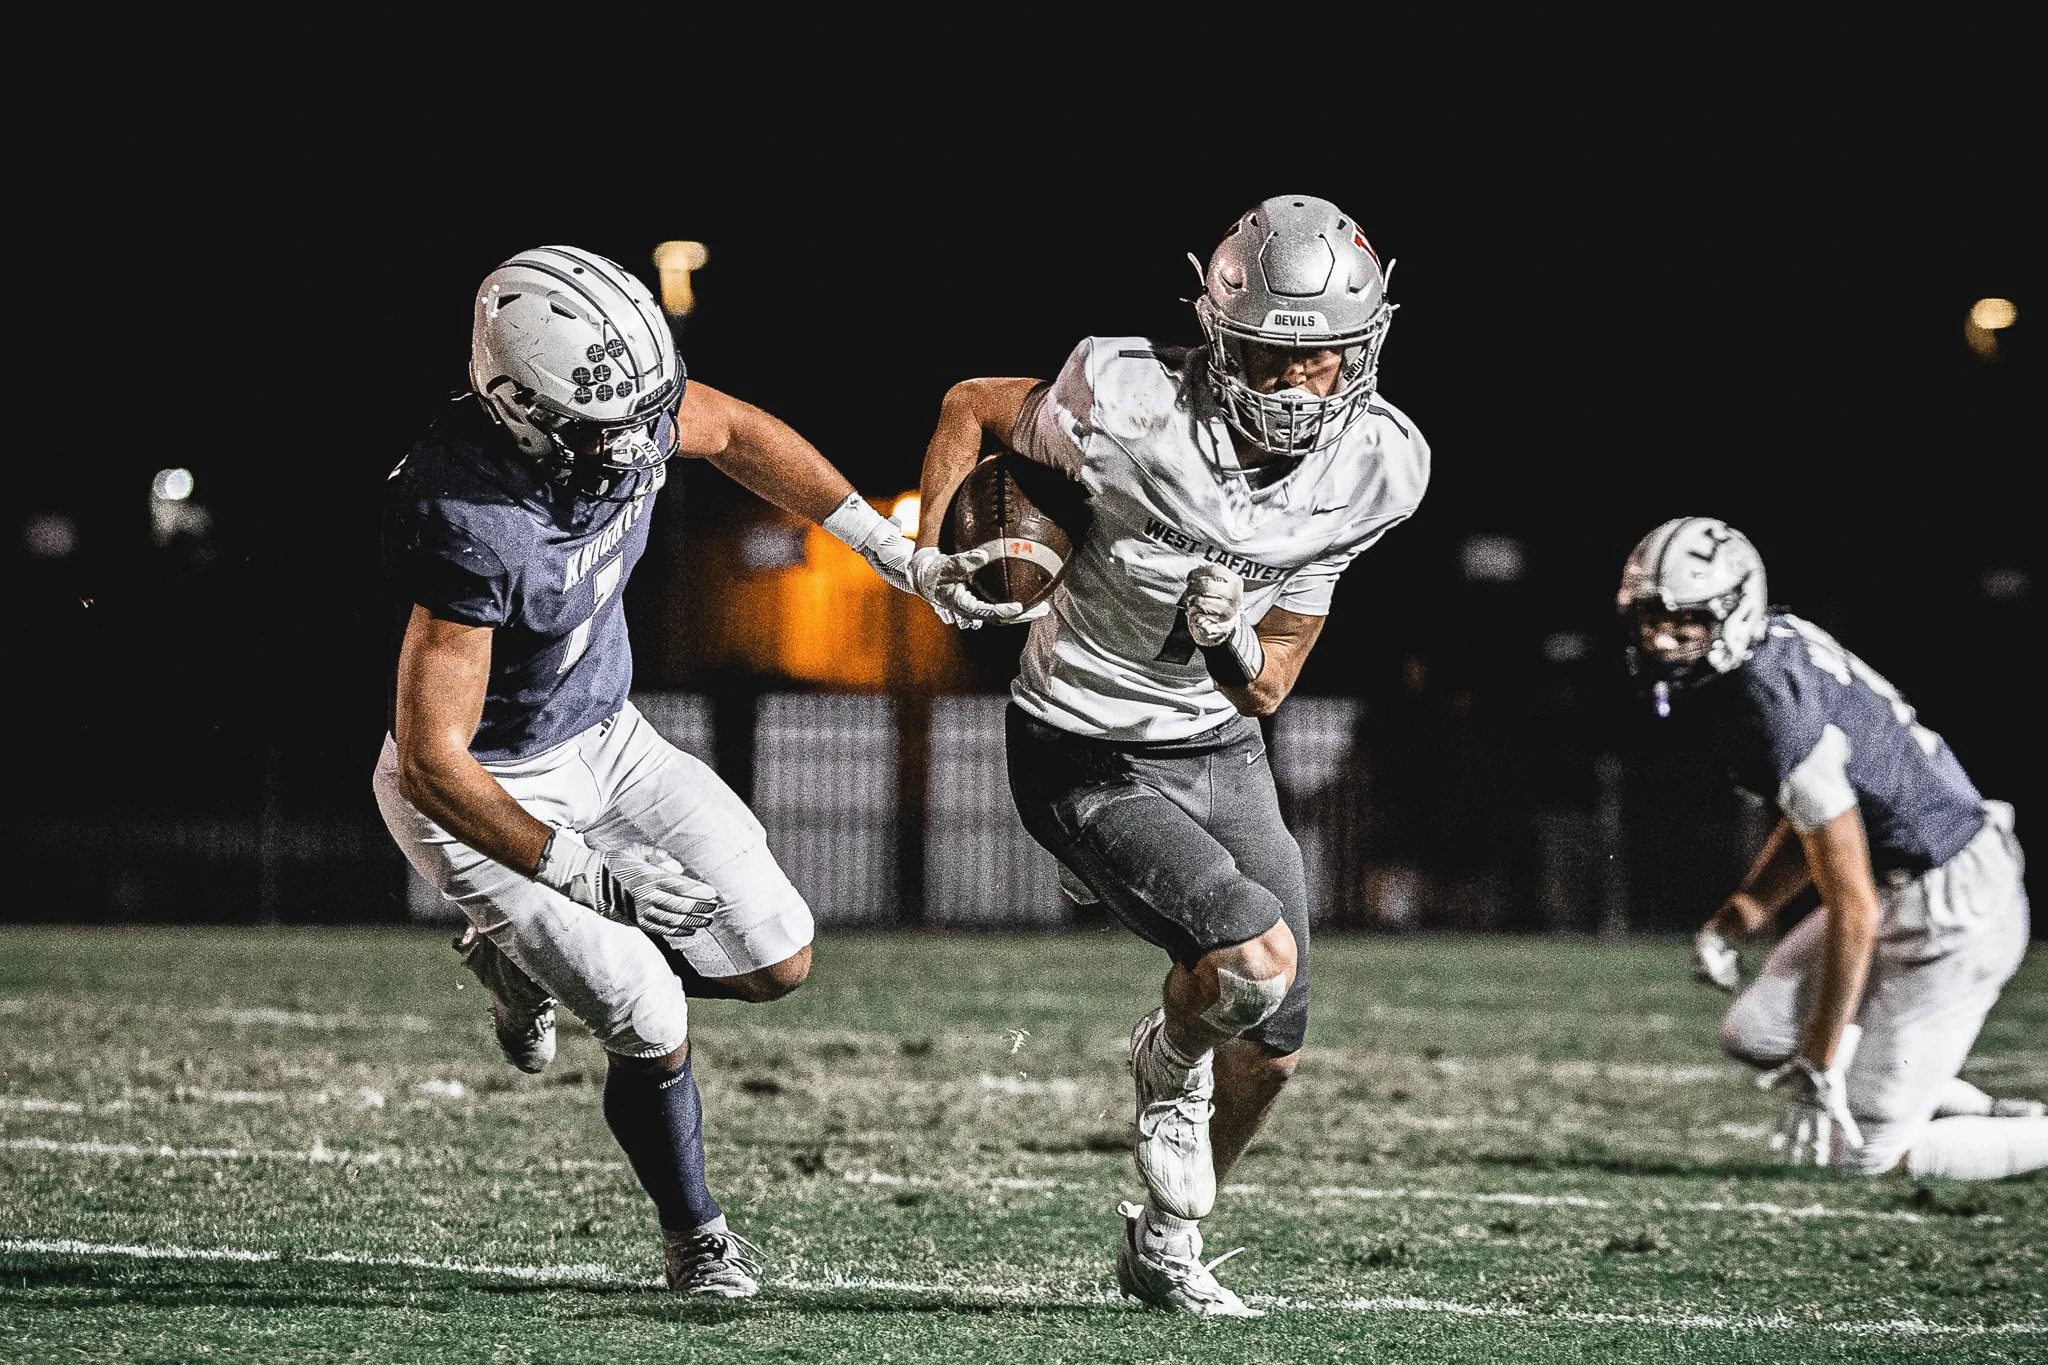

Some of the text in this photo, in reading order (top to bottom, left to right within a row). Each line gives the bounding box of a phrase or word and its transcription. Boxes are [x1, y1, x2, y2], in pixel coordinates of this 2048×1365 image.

[1274, 314, 1315, 327] DEVILS
[1343, 358, 1364, 382] Ridd
[1143, 517, 1292, 580] WEST LAFAYET
